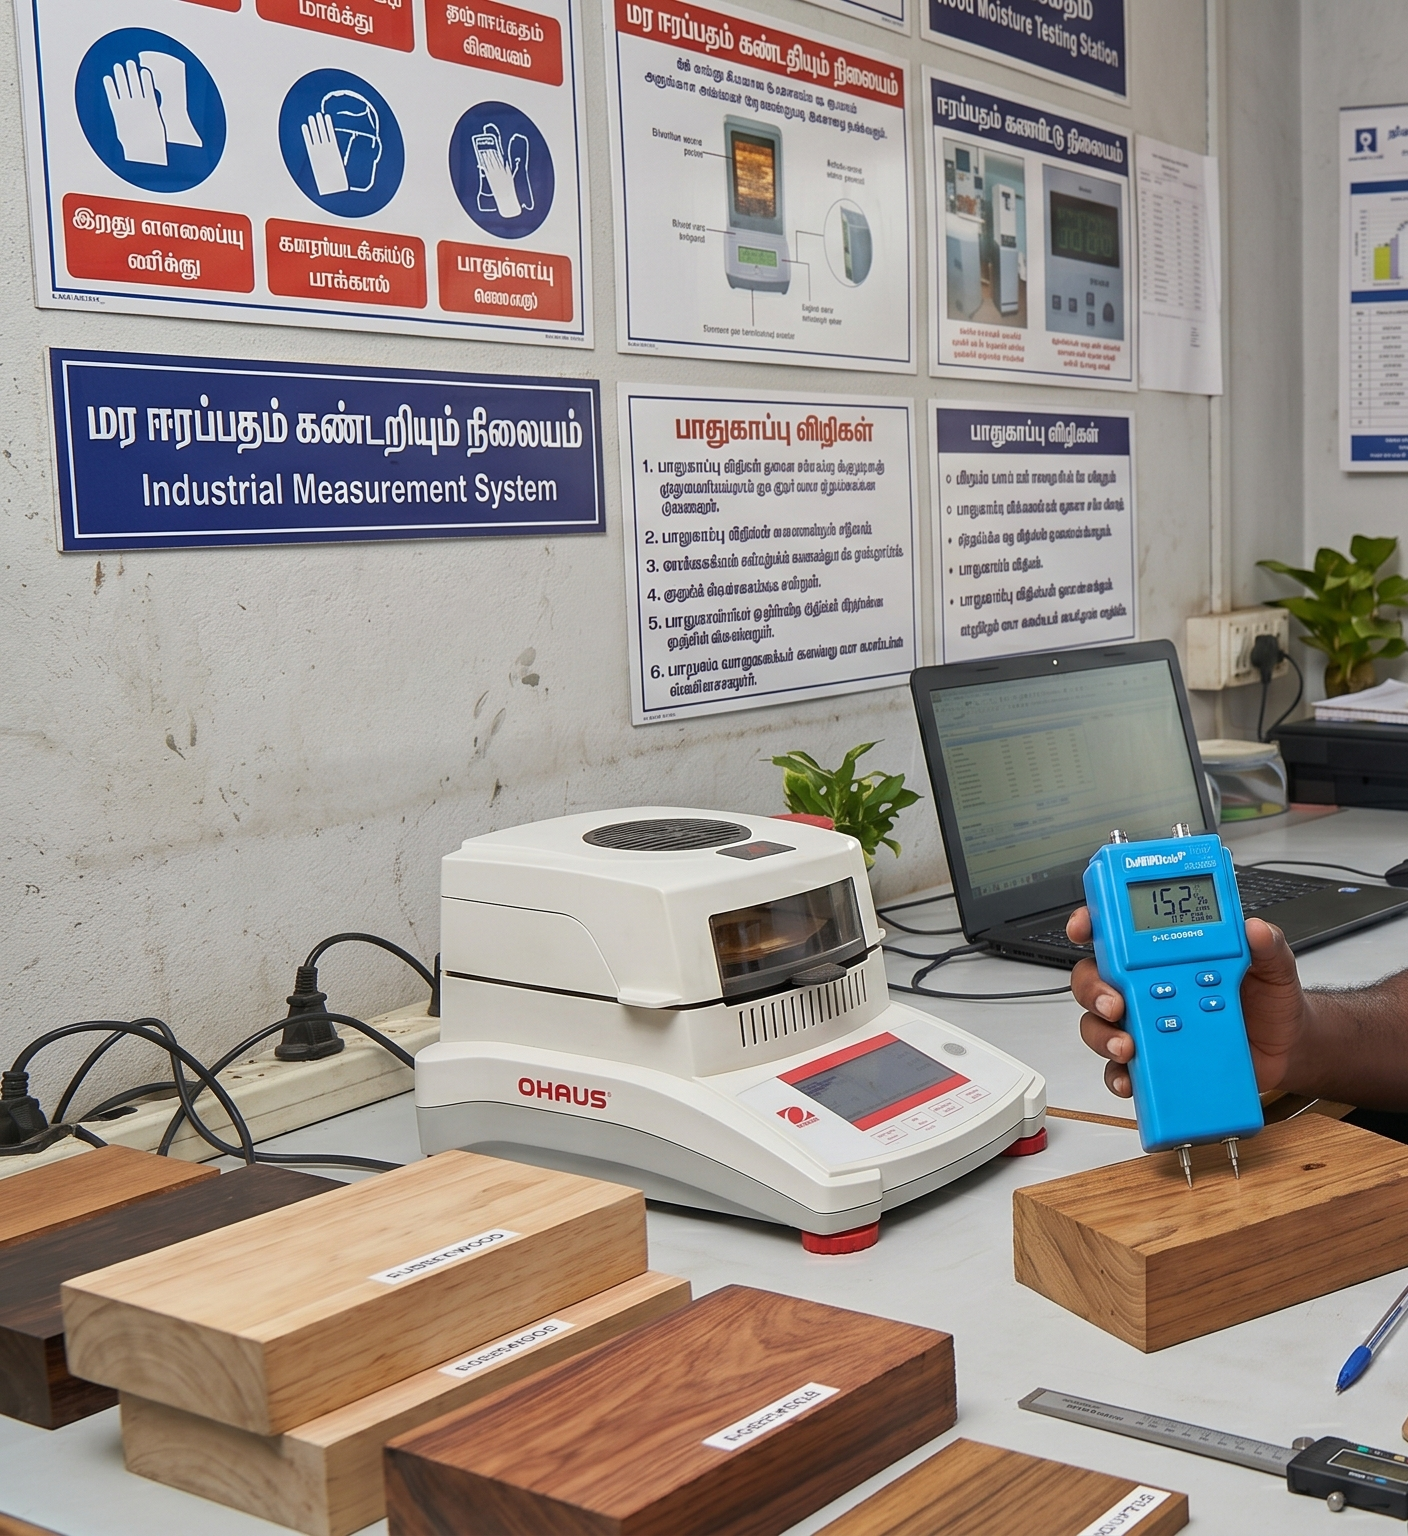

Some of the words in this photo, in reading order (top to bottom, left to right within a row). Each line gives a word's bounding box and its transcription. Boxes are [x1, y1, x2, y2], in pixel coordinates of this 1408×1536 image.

[977, 0, 1033, 36] Moisture
[1034, 15, 1078, 58] Testing
[1079, 32, 1119, 68] Station
[87, 404, 138, 450] மர
[146, 394, 289, 454] ஈரப்பதம்
[294, 399, 460, 457] கண்டறியும்
[465, 405, 584, 457] நிலையம்
[674, 411, 792, 450] பாதுகாப்பு
[642, 459, 654, 473] 1.
[142, 472, 284, 508] Industrial
[291, 472, 467, 506] Measurement
[474, 472, 558, 509] System
[644, 530, 659, 545] 2.
[645, 558, 660, 573] 3.
[646, 587, 662, 602] 4.
[647, 615, 663, 631] 5.
[649, 664, 666, 679] 6.
[518, 1077, 607, 1109] OHAUS
